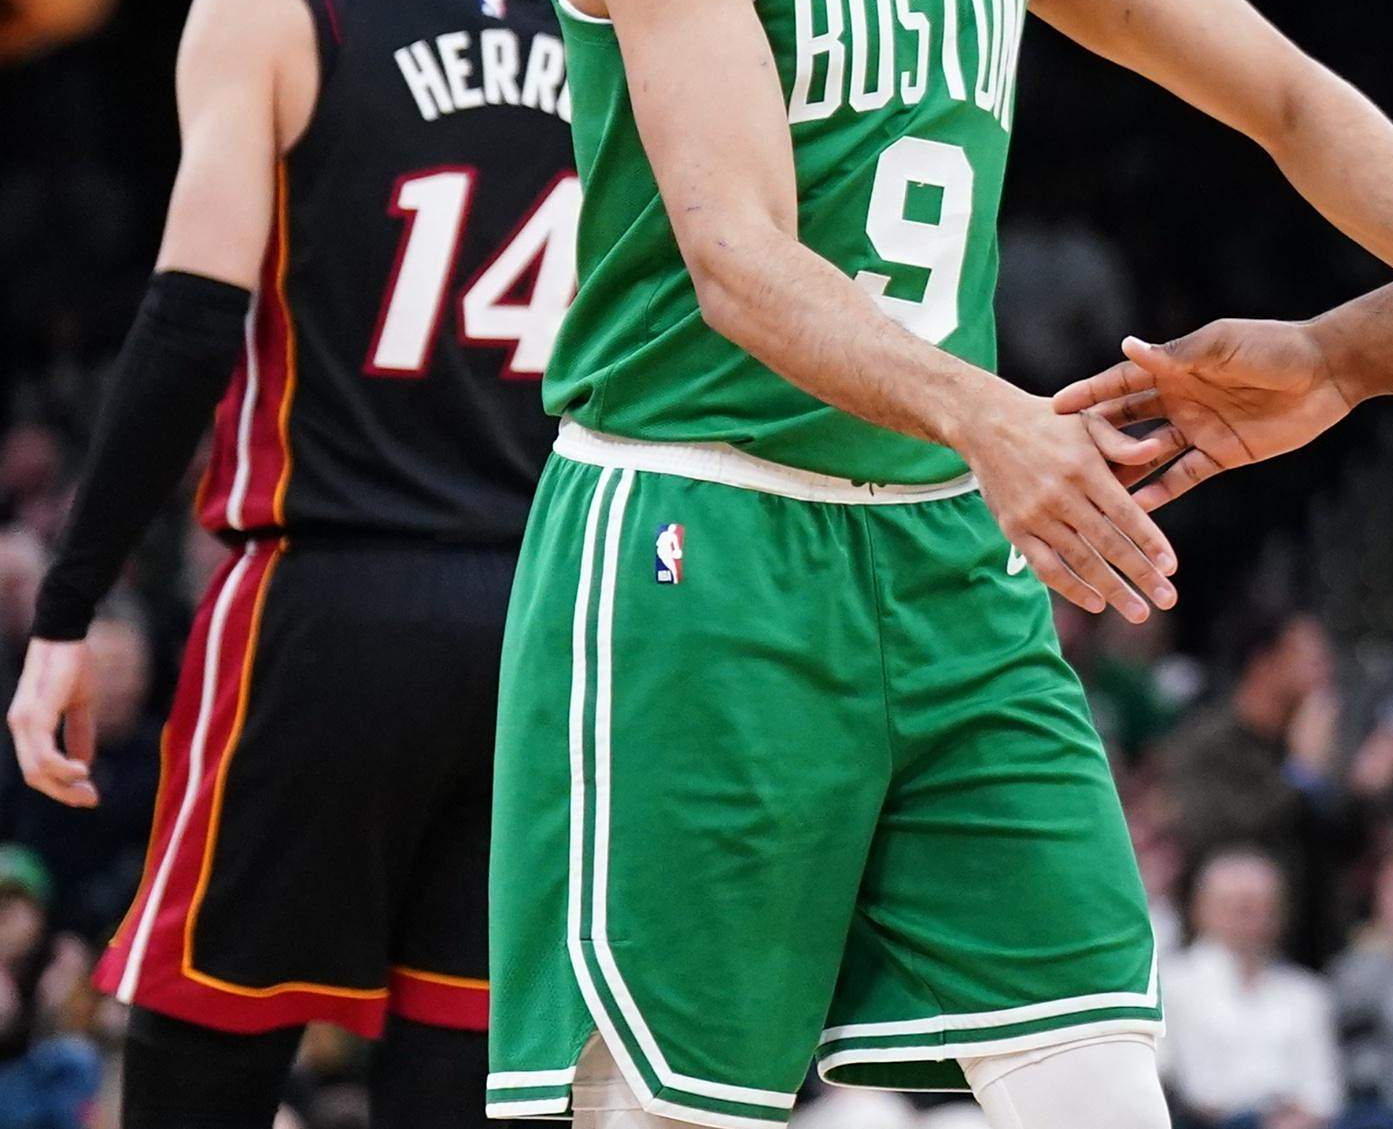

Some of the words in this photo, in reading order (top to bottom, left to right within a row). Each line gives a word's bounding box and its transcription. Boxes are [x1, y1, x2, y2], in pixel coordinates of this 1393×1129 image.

[393, 28, 572, 124] HERR
[364, 165, 583, 378] 14
[852, 135, 975, 345] 9
